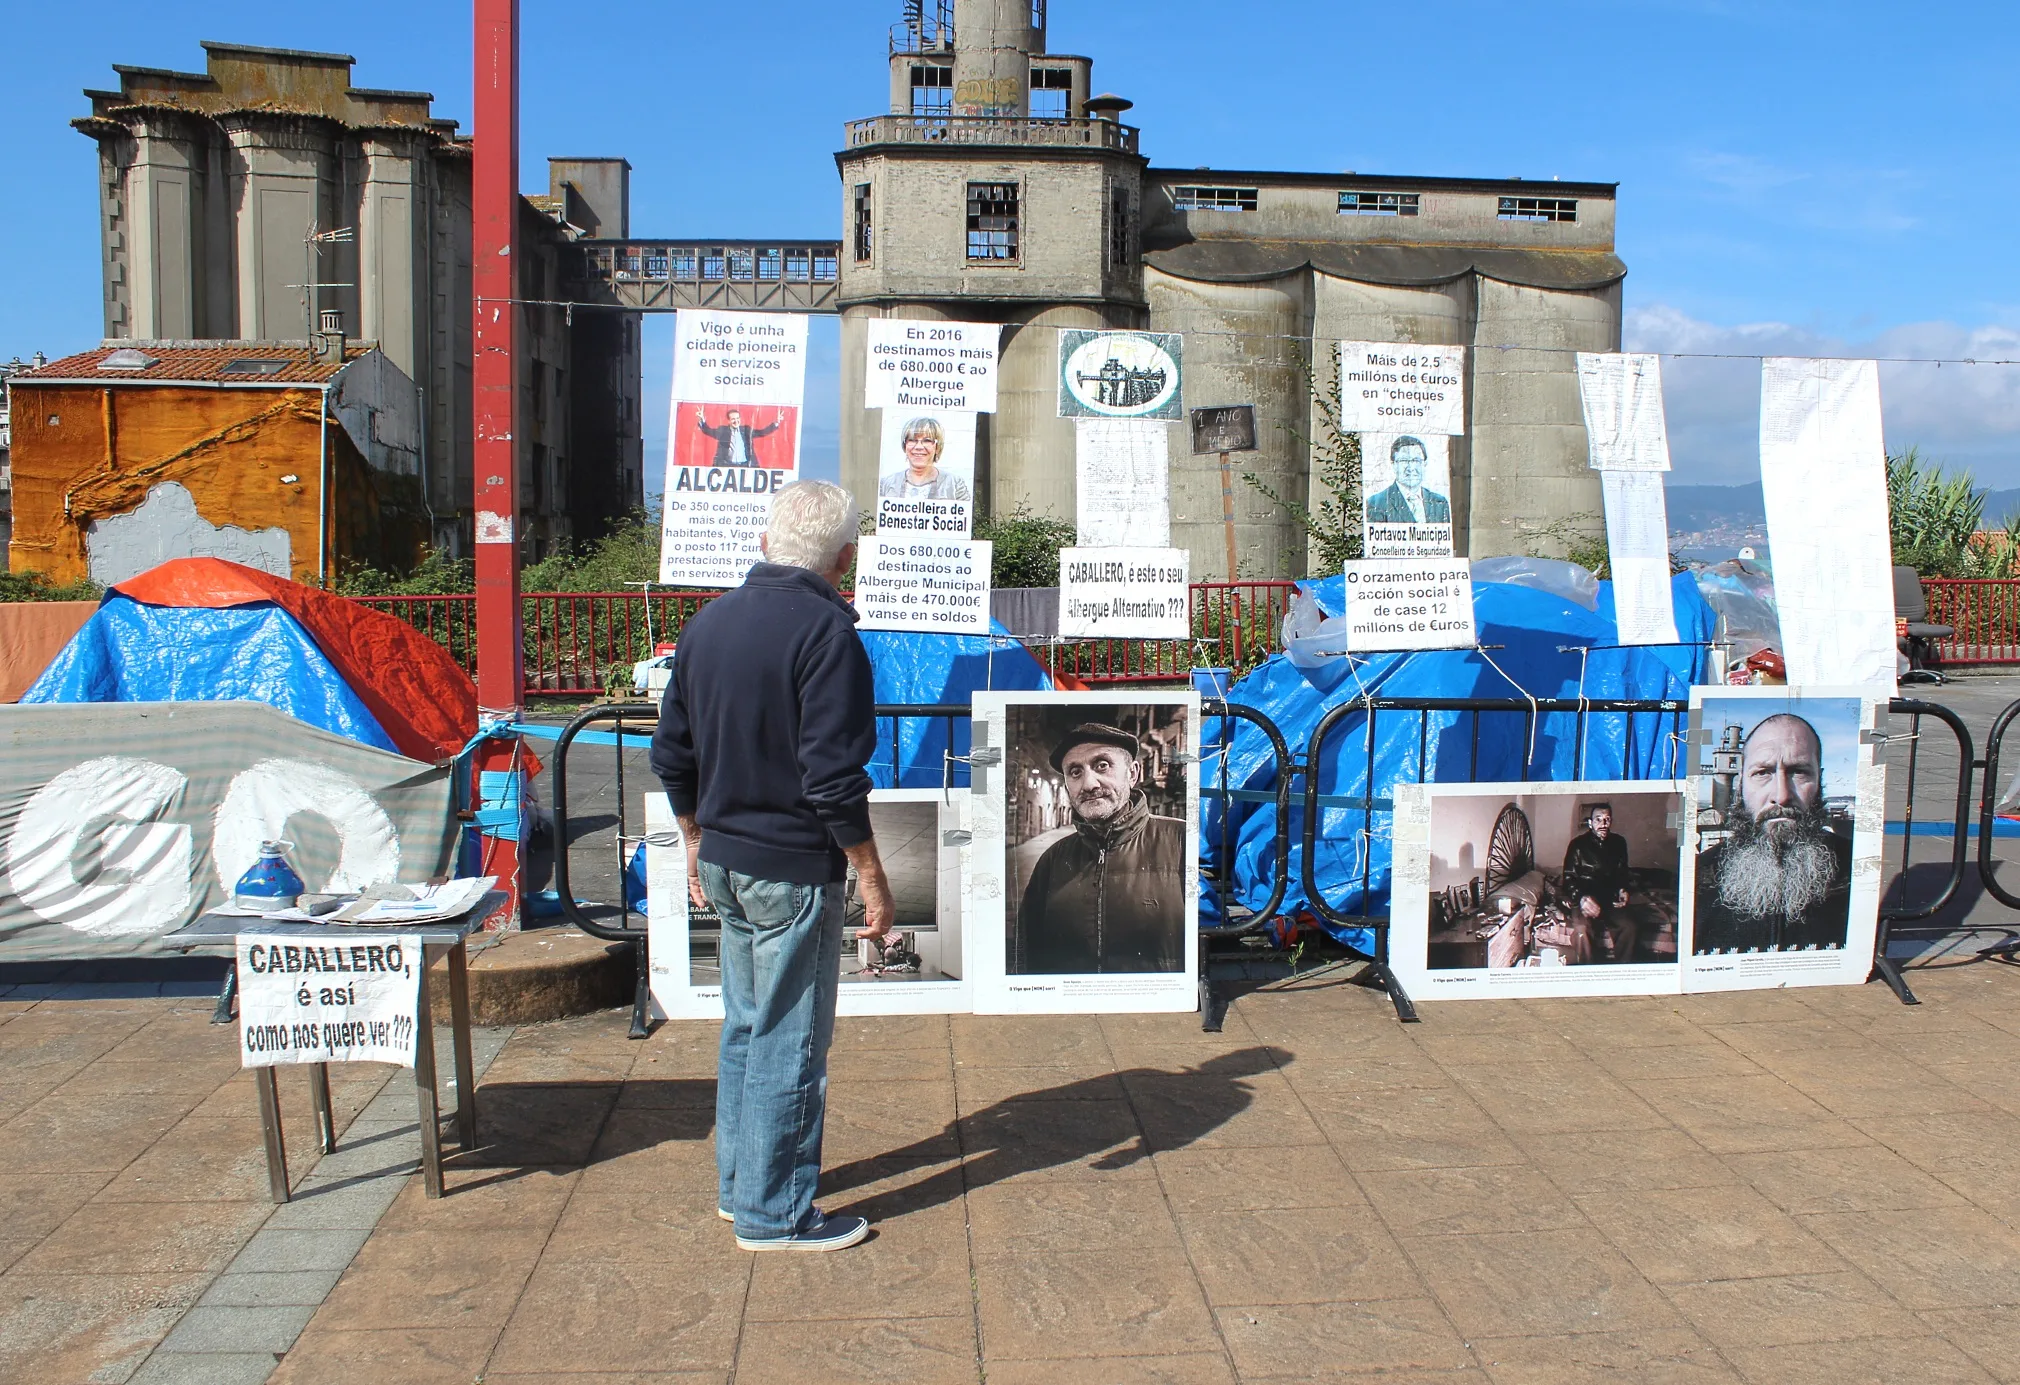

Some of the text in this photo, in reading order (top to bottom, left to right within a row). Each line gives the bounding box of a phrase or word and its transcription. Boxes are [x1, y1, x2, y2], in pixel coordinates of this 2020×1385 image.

[700, 321, 784, 336] Vigo é unha
[907, 328, 962, 341] En 2016
[686, 339, 796, 354] cidade pioneira
[873, 343, 993, 359] destinamos máis
[700, 357, 780, 370] en servizos
[879, 359, 987, 375] de 680.000 € ao
[1367, 354, 1440, 369] Máis de 2,5
[714, 374, 764, 386] sociais
[1348, 370, 1397, 383] millóns
[1401, 372, 1417, 383] de
[900, 377, 964, 392] Albergue
[897, 393, 965, 409] Municipal
[1362, 389, 1378, 398] en
[676, 467, 784, 494] ALCALDE
[672, 501, 766, 513] De 350 concellos
[882, 500, 965, 515] Concelleira de
[689, 516, 715, 525] máis
[718, 516, 732, 525] de
[879, 512, 967, 532] Benestar Social
[730, 529, 755, 541] Vigo
[1369, 526, 1451, 545] Portavoz Municipal
[685, 543, 716, 553] posto
[720, 542, 738, 552] 117
[879, 544, 972, 559] Dos 680.000 €
[1371, 545, 1451, 557] Concelleiro de Seguridade
[667, 555, 732, 566] prestacións
[877, 560, 972, 575] destinados ao
[672, 570, 685, 578] en
[688, 569, 735, 578] servizos
[1069, 562, 1183, 587] CABALLERO, é este o seu
[1347, 571, 1469, 584] O orzamento para
[858, 575, 989, 593] Albergue Municipal,
[865, 592, 897, 603] máis
[901, 593, 918, 604] de
[1358, 585, 1460, 600] acción social é
[868, 610, 977, 623] vanse en soldos
[1068, 597, 1184, 623] Albergue Alternativo ???
[1373, 603, 1447, 616] de case 12
[1353, 621, 1404, 633] millóns
[1408, 621, 1425, 632] de
[250, 944, 410, 979] CABALLERO,
[297, 981, 354, 1006] é así
[247, 1024, 288, 1052] como
[293, 1023, 319, 1049] nos
[323, 1021, 365, 1056] quere
[369, 1020, 390, 1048] ver
